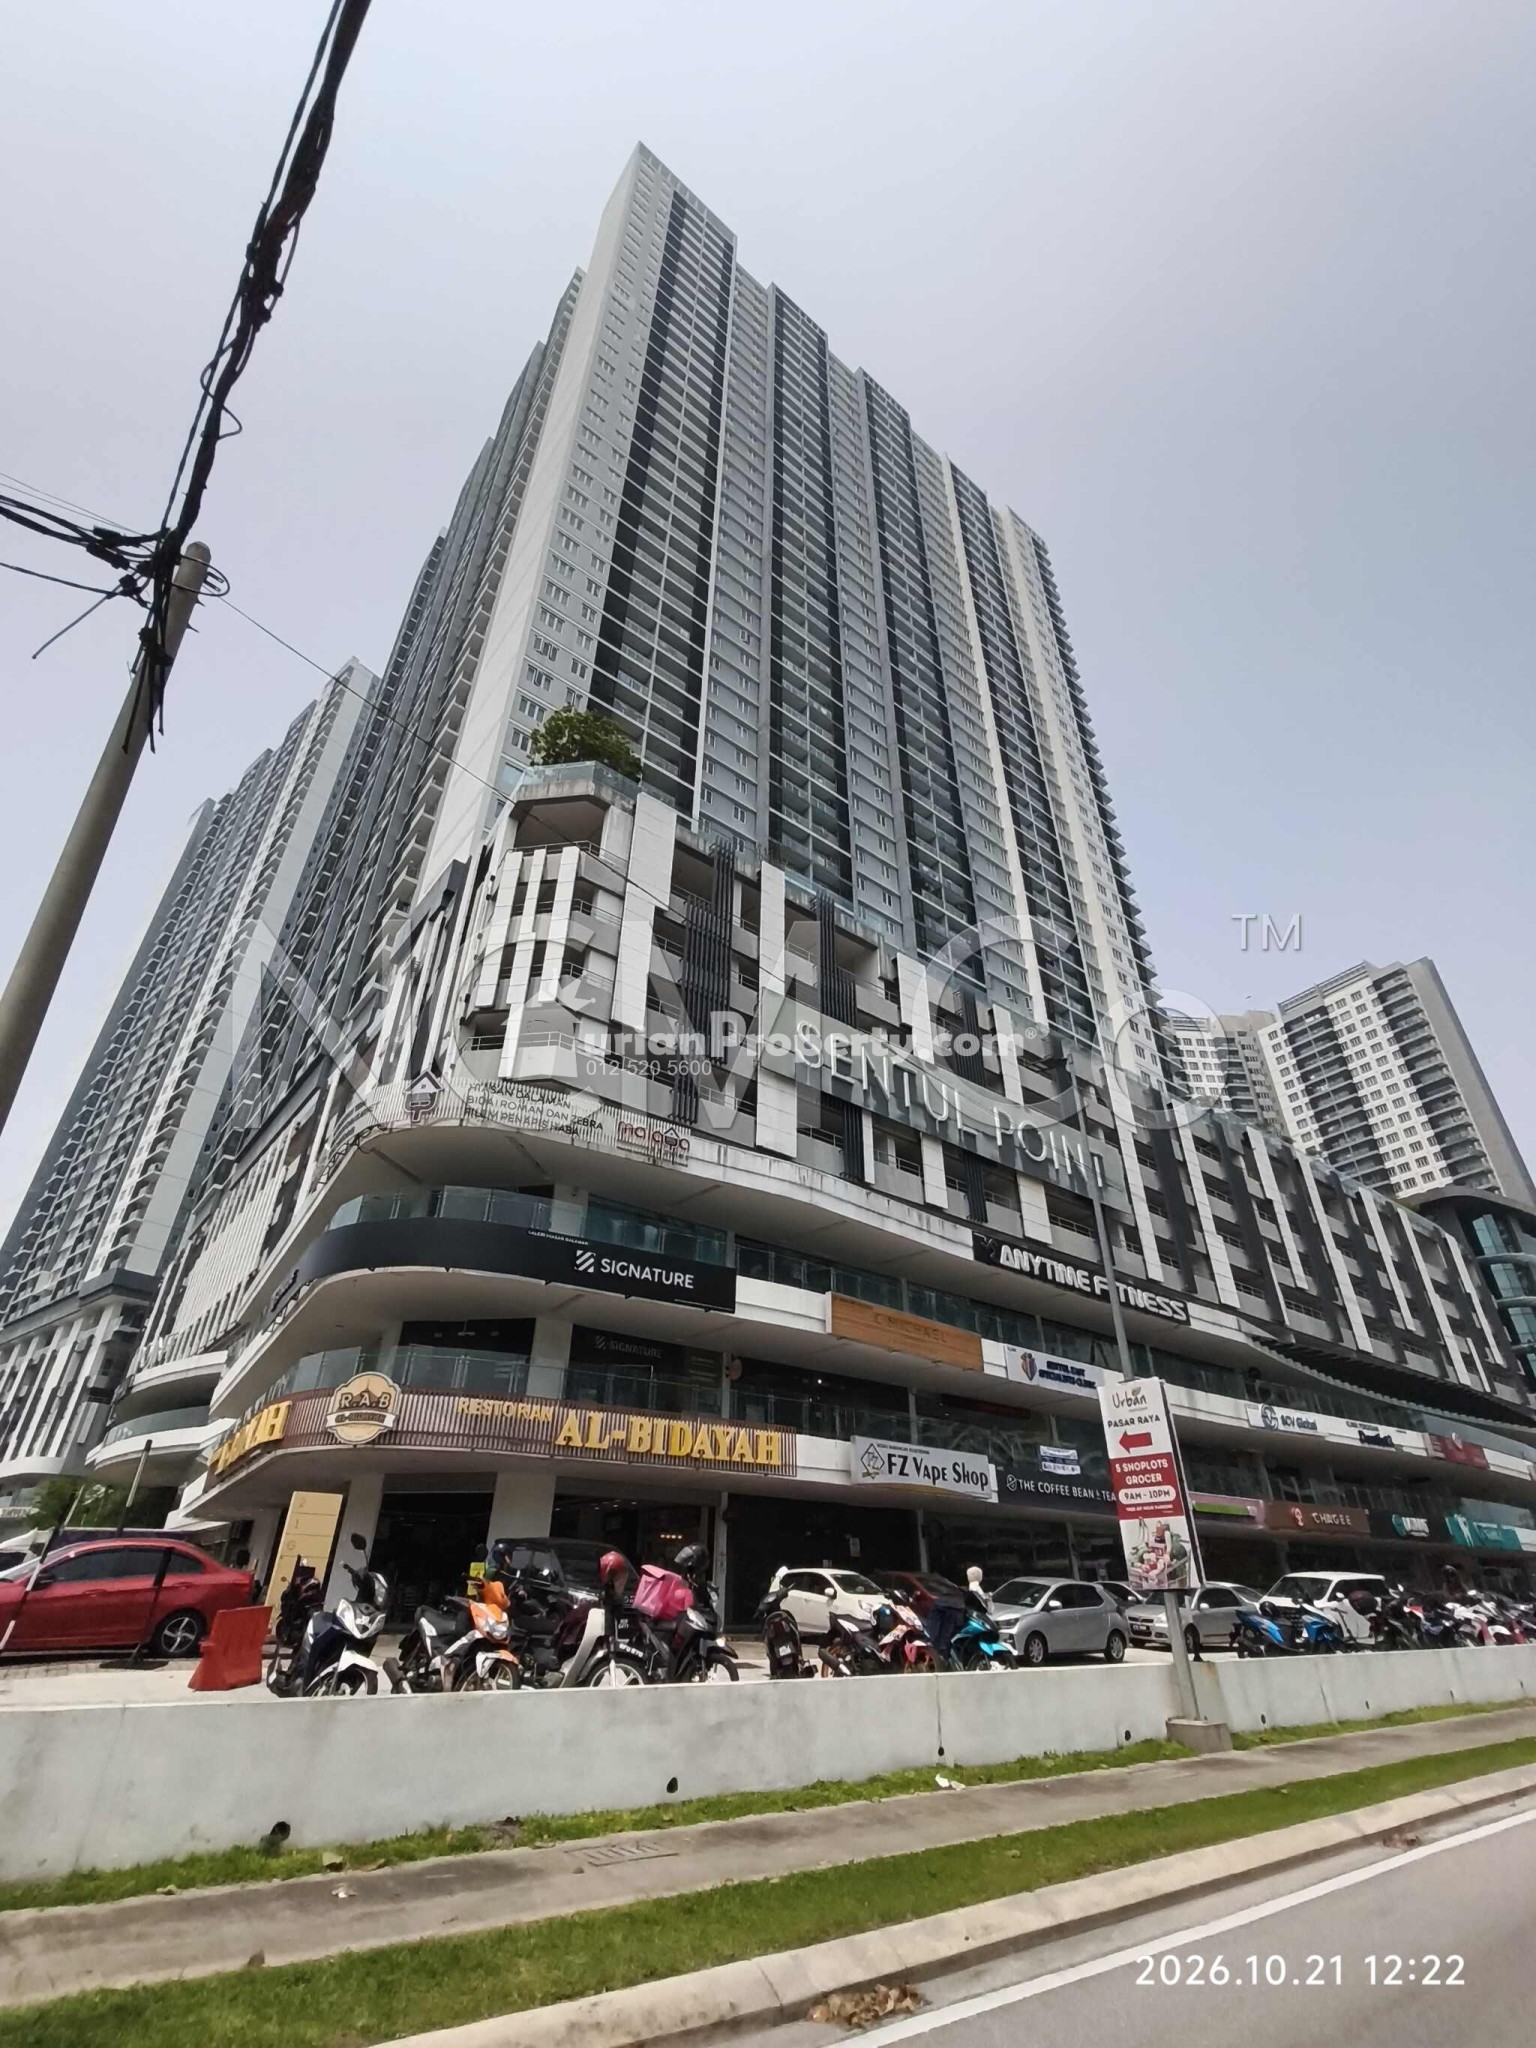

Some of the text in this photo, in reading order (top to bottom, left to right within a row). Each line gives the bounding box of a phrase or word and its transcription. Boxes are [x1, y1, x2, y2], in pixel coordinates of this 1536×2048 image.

[796, 1020, 1104, 1188] SENTUL POINT
[546, 1108, 569, 1121] DAN
[571, 1114, 604, 1130] ZEBRA
[600, 1258, 694, 1289] SIGNATURE
[1000, 1243, 1187, 1321] ANYTIME FTNESS
[609, 1340, 663, 1360] SIGNATURE
[457, 1397, 781, 1467] RESTORAN AL-BIDAYAH
[1107, 1413, 1161, 1429] PASAR RAYA
[887, 1453, 910, 1477] FZ
[1122, 1458, 1169, 1472] SHOPLOTS
[1125, 1472, 1163, 1486] GROCER
[1018, 1480, 1036, 1492] THE
[1038, 1481, 1071, 1497] COFFEE
[1072, 1485, 1095, 1499] BEAN
[1102, 1490, 1117, 1502] TEA
[1124, 1491, 1142, 1501] 9AM
[1149, 1489, 1171, 1500] 10PM
